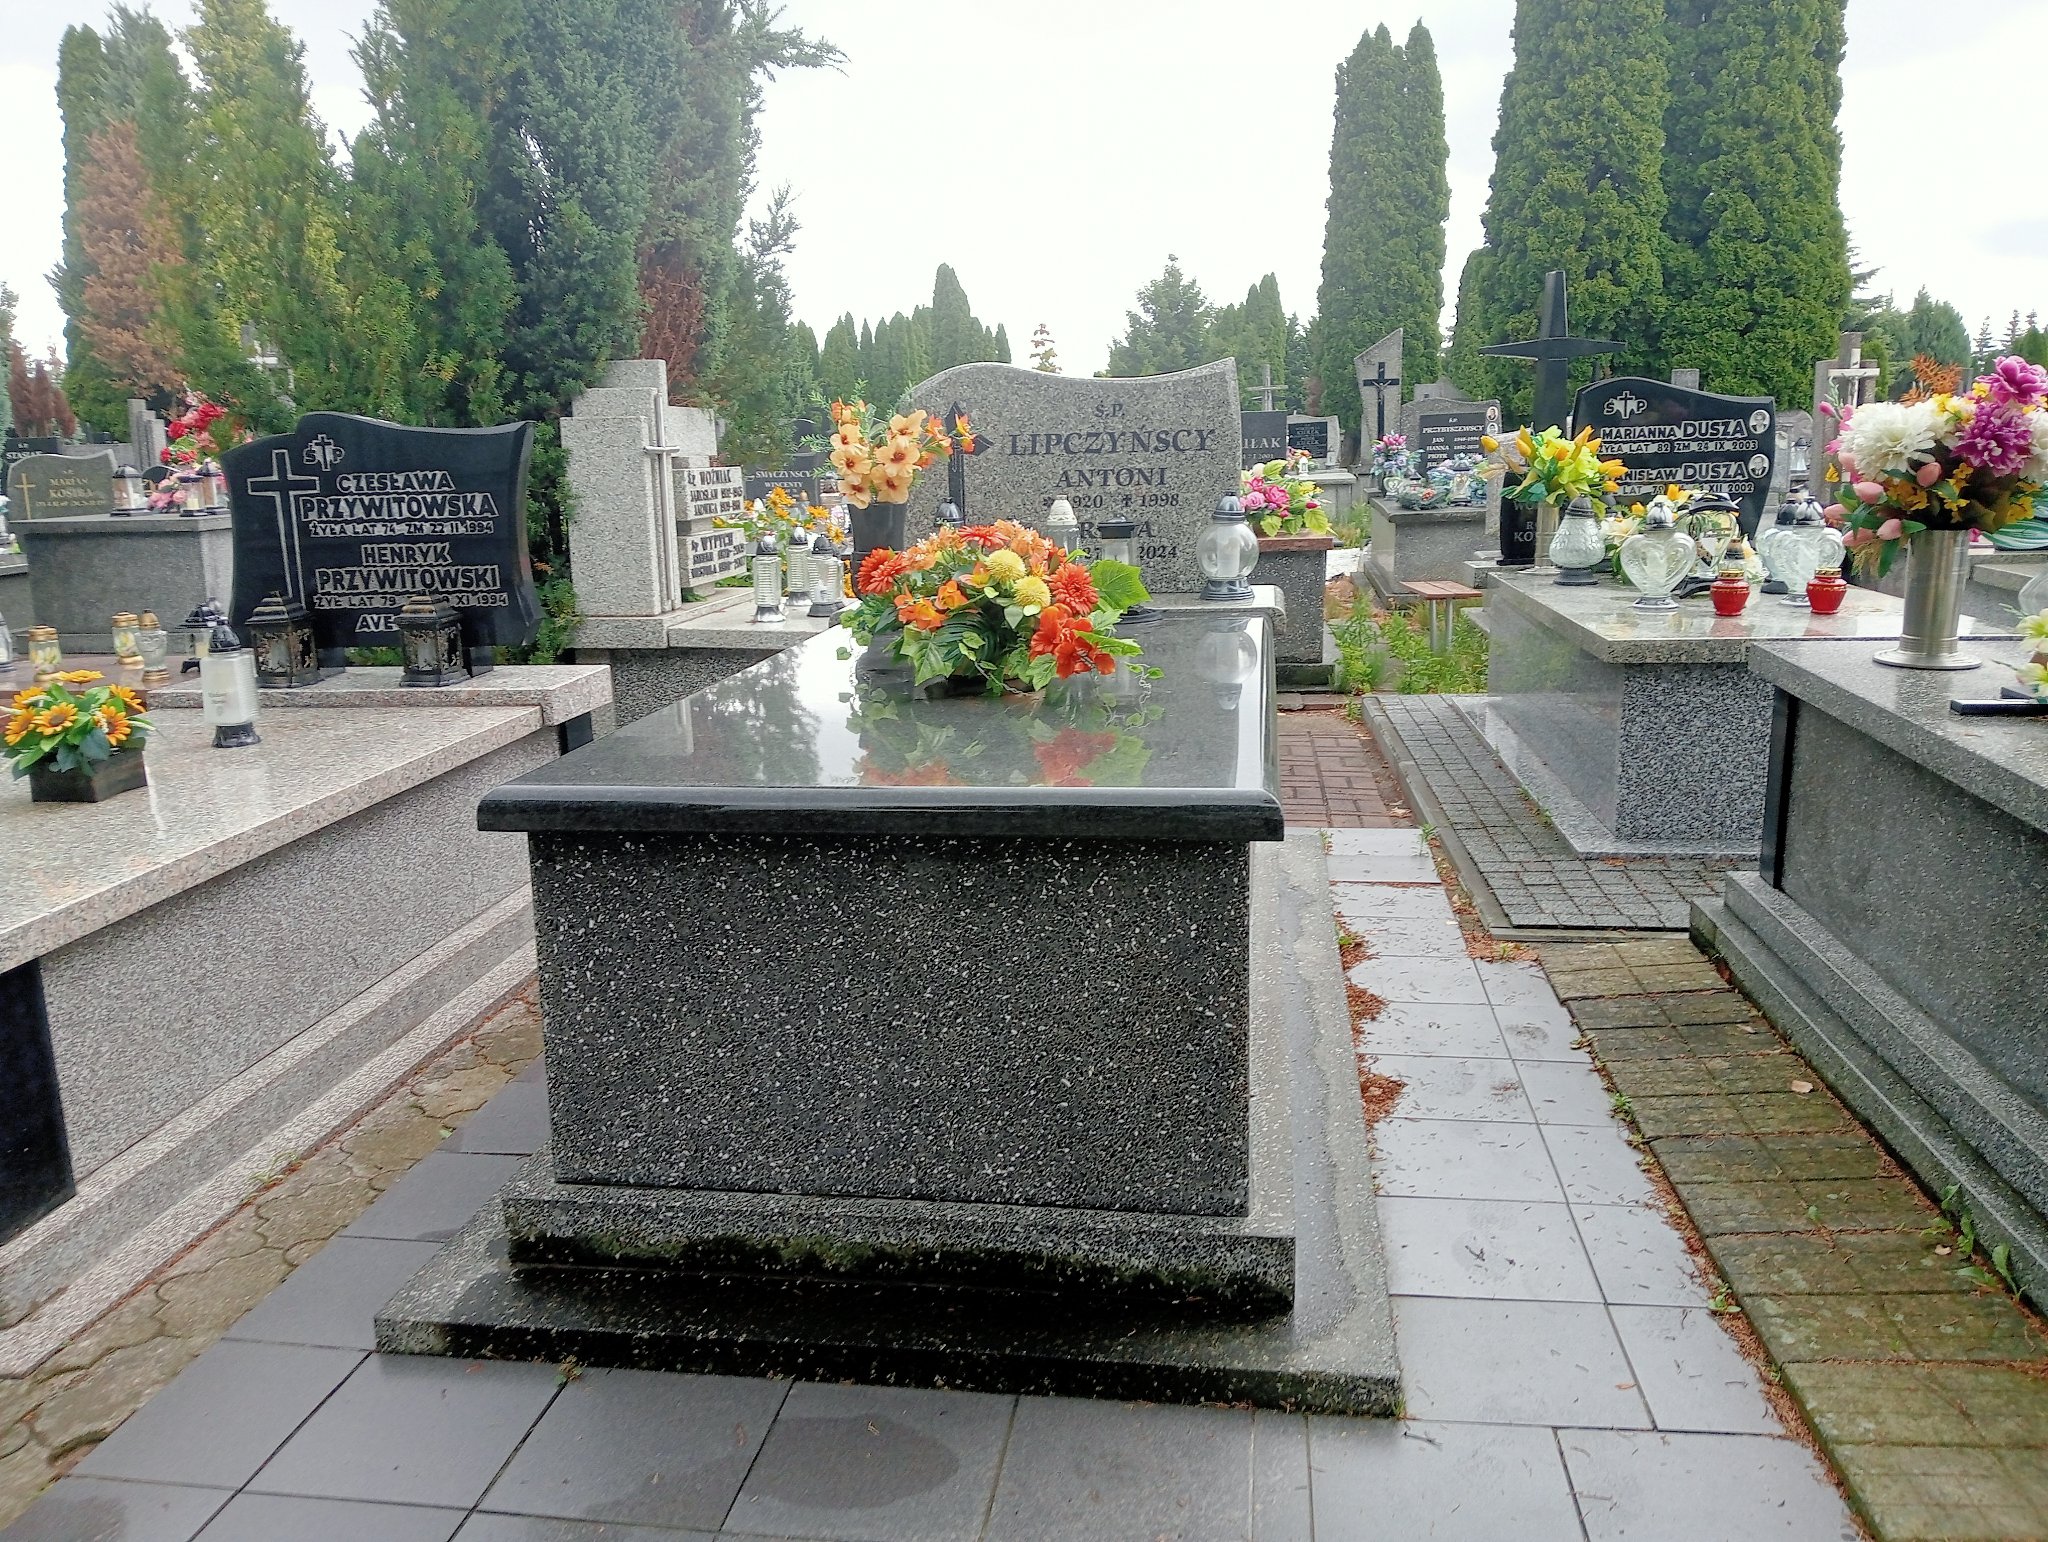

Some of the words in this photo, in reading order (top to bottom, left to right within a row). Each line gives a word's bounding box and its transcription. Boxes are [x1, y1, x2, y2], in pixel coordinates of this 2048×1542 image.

[1600, 425, 1680, 442] MARIANNA
[1680, 419, 1748, 440] DUSZA
[1009, 424, 1216, 456] LIPCZYŃSCY
[1242, 437, 1281, 448] IŁAK
[1629, 443, 1651, 453] LAT
[1657, 442, 1671, 453] 82
[1675, 441, 1691, 452] ZM
[1696, 441, 1710, 451] 24
[1714, 440, 1726, 450] IX
[1731, 439, 1758, 450] 2003
[700, 469, 731, 486] WOŹNIAK
[1056, 467, 1168, 488] ANTONI
[1617, 467, 1680, 482] NISŁAW
[1680, 462, 1749, 482] DUSZA
[336, 471, 456, 493] CZESŁAWA
[1622, 485, 1642, 495] LAT
[1708, 484, 1723, 494] XII
[1727, 482, 1754, 493] 2002
[300, 493, 499, 521] PRZYWITOWSKA
[1140, 493, 1180, 508] 1998
[310, 521, 347, 537] ŻYŁA
[351, 523, 377, 536] LAT
[381, 522, 397, 535] 74
[404, 522, 424, 535] ZM
[429, 522, 445, 535] 22
[463, 520, 494, 534] 1994
[361, 542, 452, 566] HENRYK
[1138, 546, 1178, 560] 2024
[315, 565, 500, 594] PRZYWITOWSKI
[347, 595, 375, 608] LAT
[379, 595, 397, 608] 79
[455, 594, 471, 606] XI
[476, 592, 508, 606] 1994
[355, 614, 398, 632] AVE
